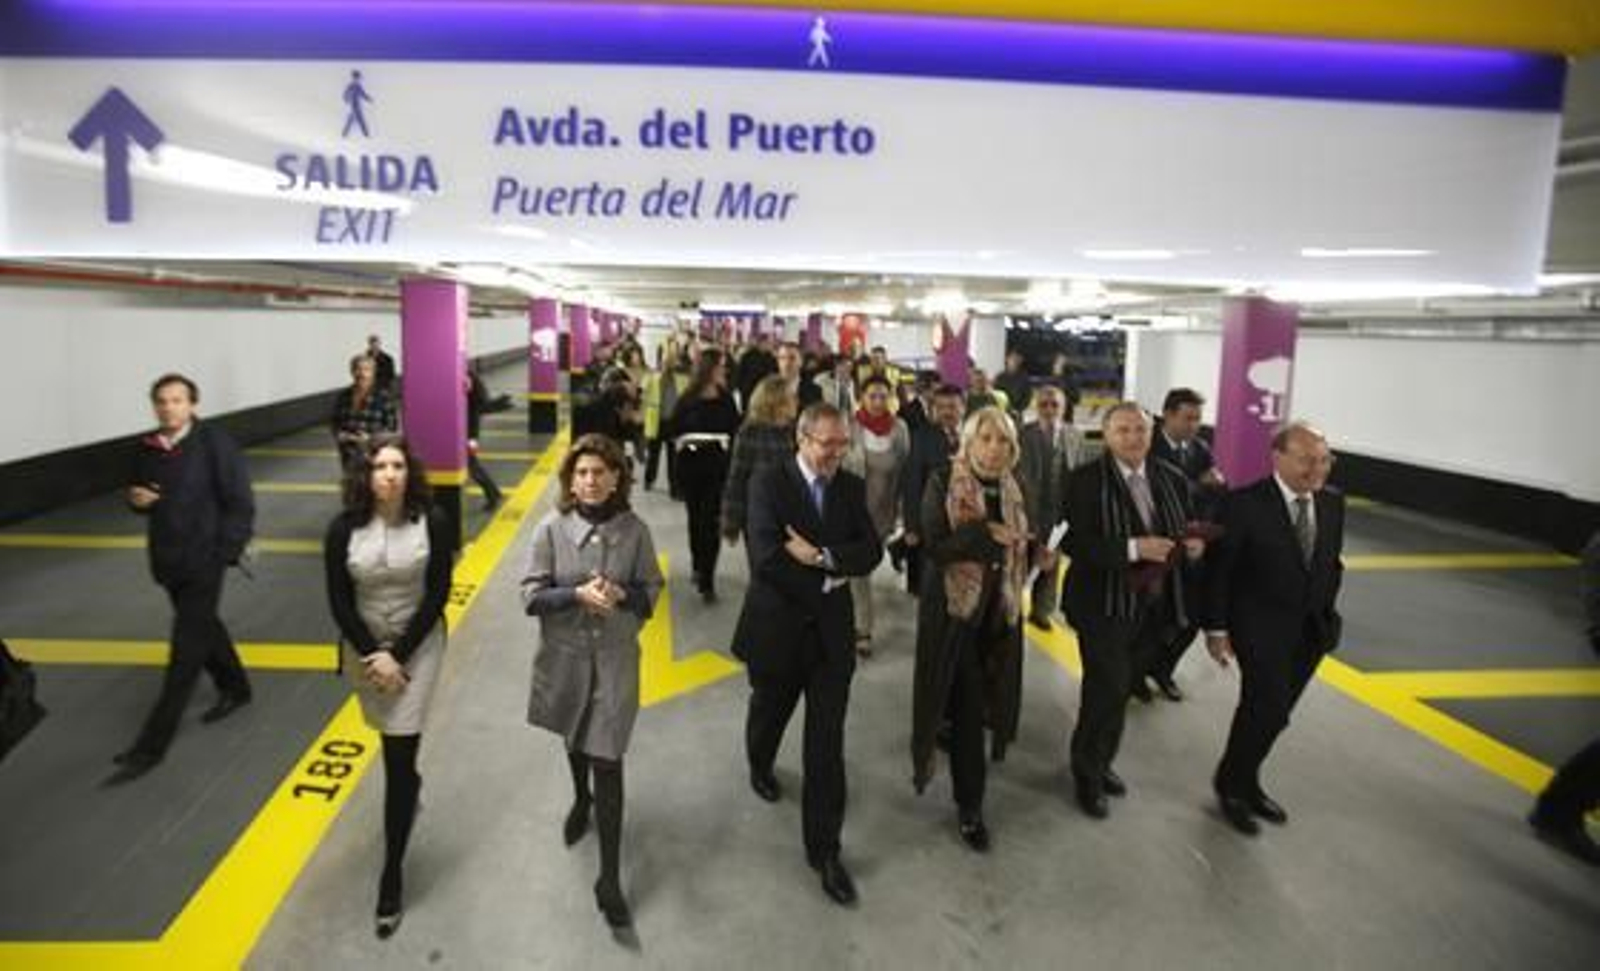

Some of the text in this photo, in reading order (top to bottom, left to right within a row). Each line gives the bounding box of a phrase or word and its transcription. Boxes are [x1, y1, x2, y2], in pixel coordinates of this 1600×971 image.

[494, 107, 876, 156] Avda. del Puerto
[275, 153, 439, 193] SALIDA
[493, 177, 796, 220] Puerta del Mar
[315, 206, 395, 244] EXIT
[1246, 395, 1279, 422] -1
[293, 740, 366, 803] 180
